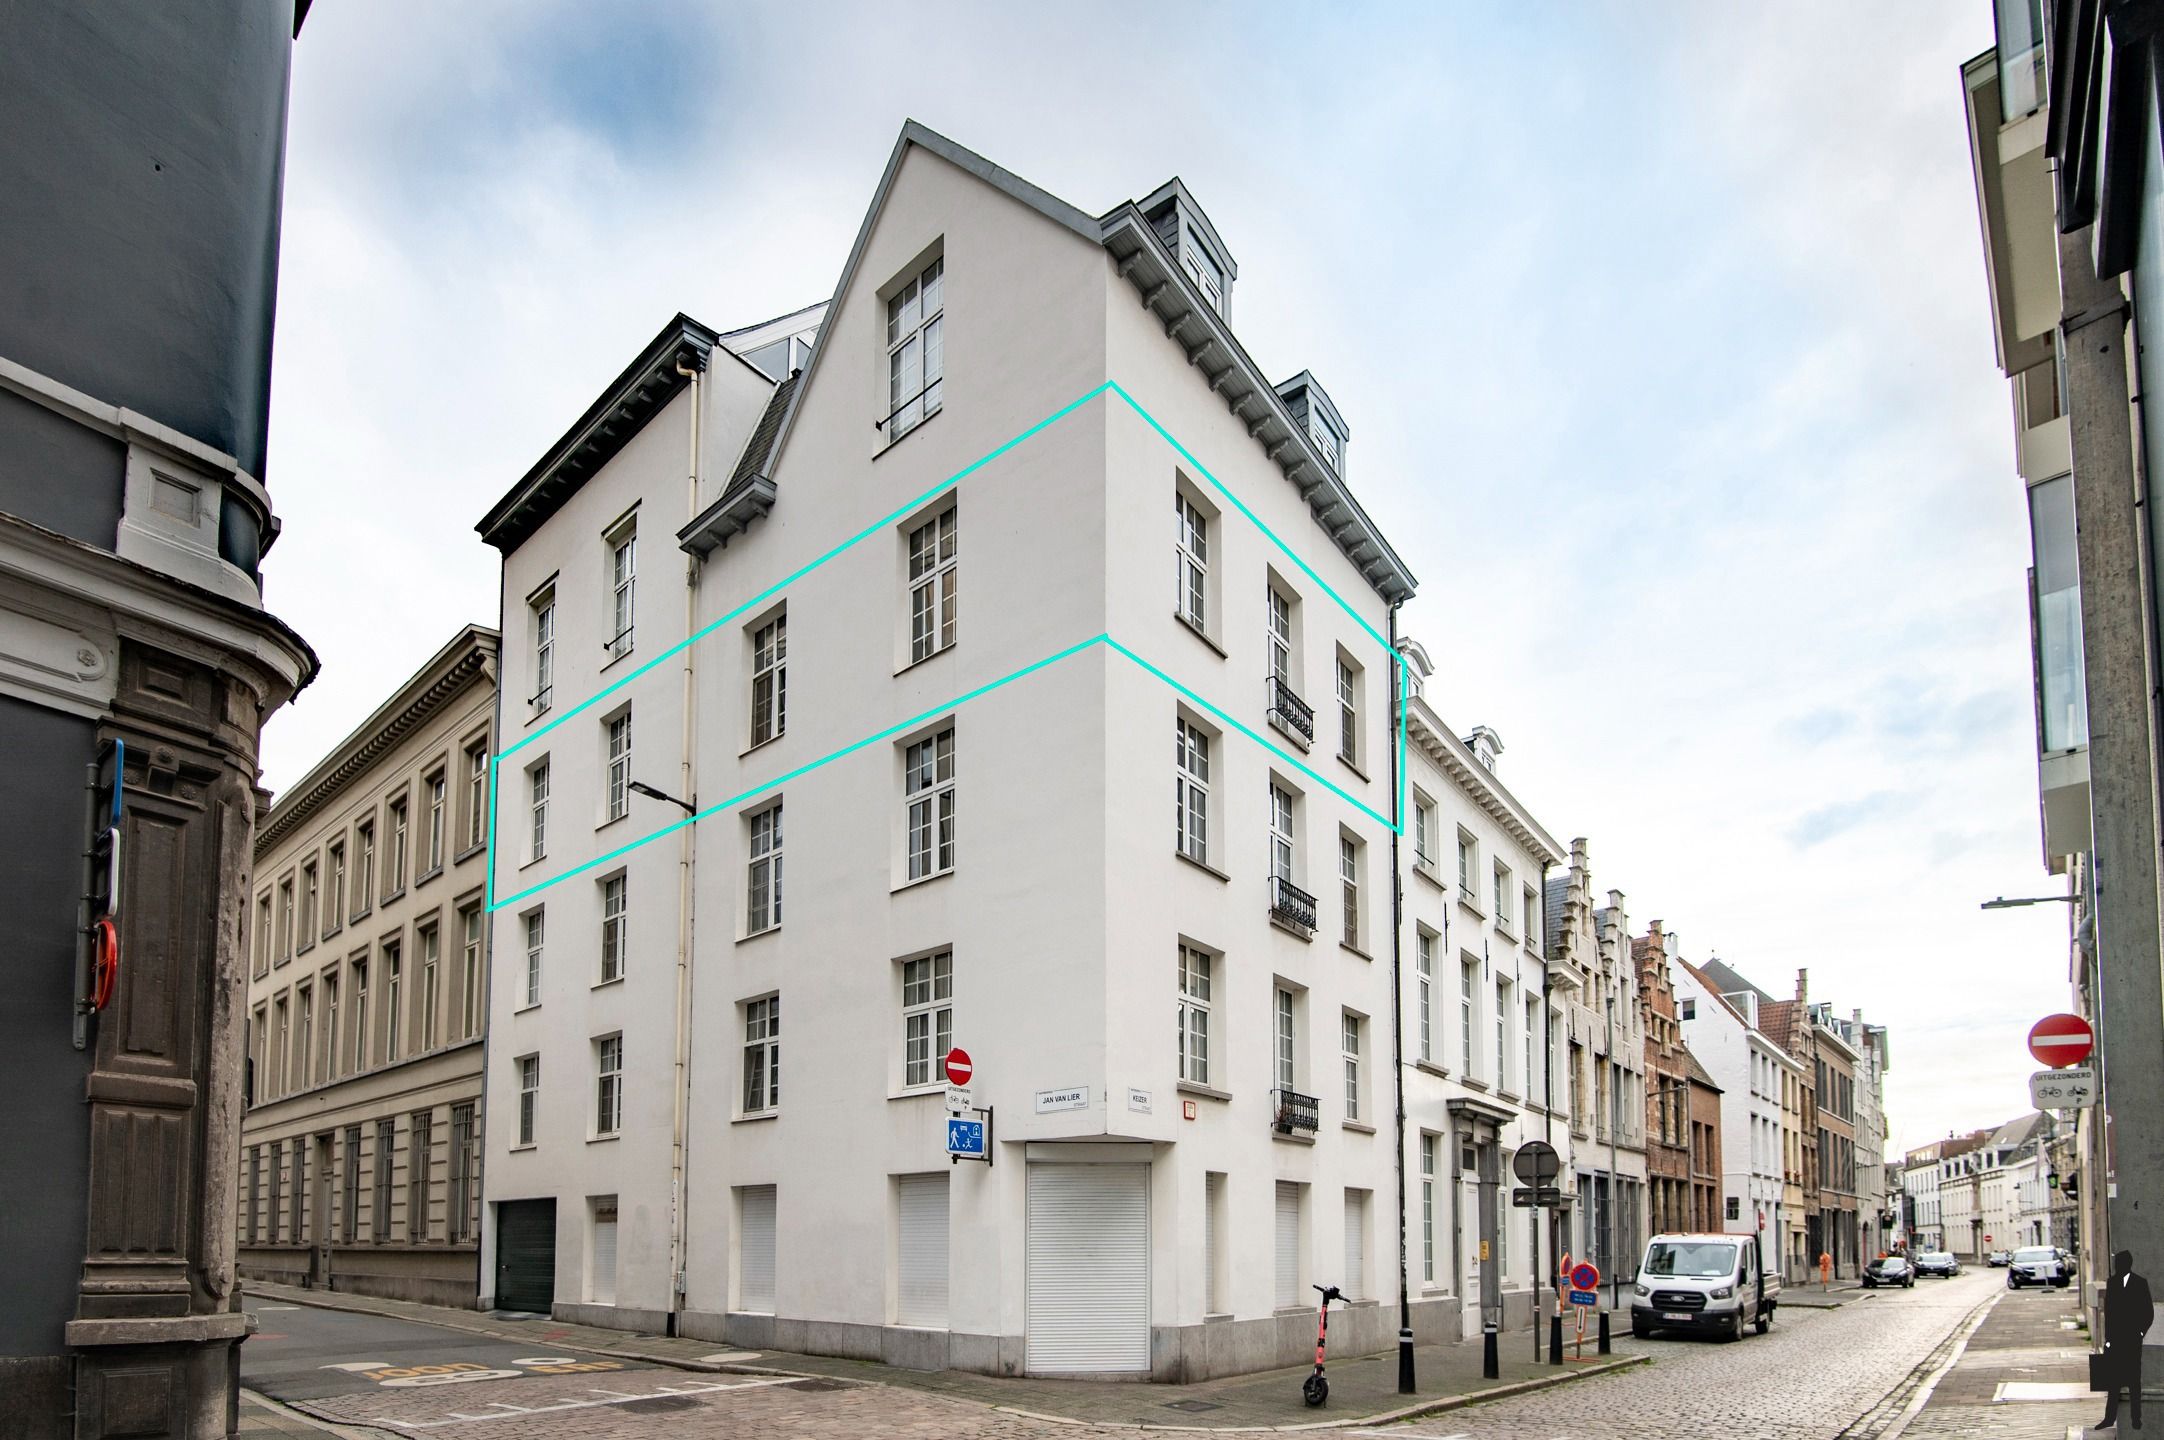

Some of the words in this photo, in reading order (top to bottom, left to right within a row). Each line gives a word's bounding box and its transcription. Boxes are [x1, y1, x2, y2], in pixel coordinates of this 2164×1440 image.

[2035, 1071, 2092, 1082] UITGEZONDERD
[1042, 1096, 1054, 1104] JAN
[1054, 1095, 1067, 1103] VAN
[1067, 1093, 1081, 1101] LIER
[1132, 1095, 1147, 1104] KEIZER
